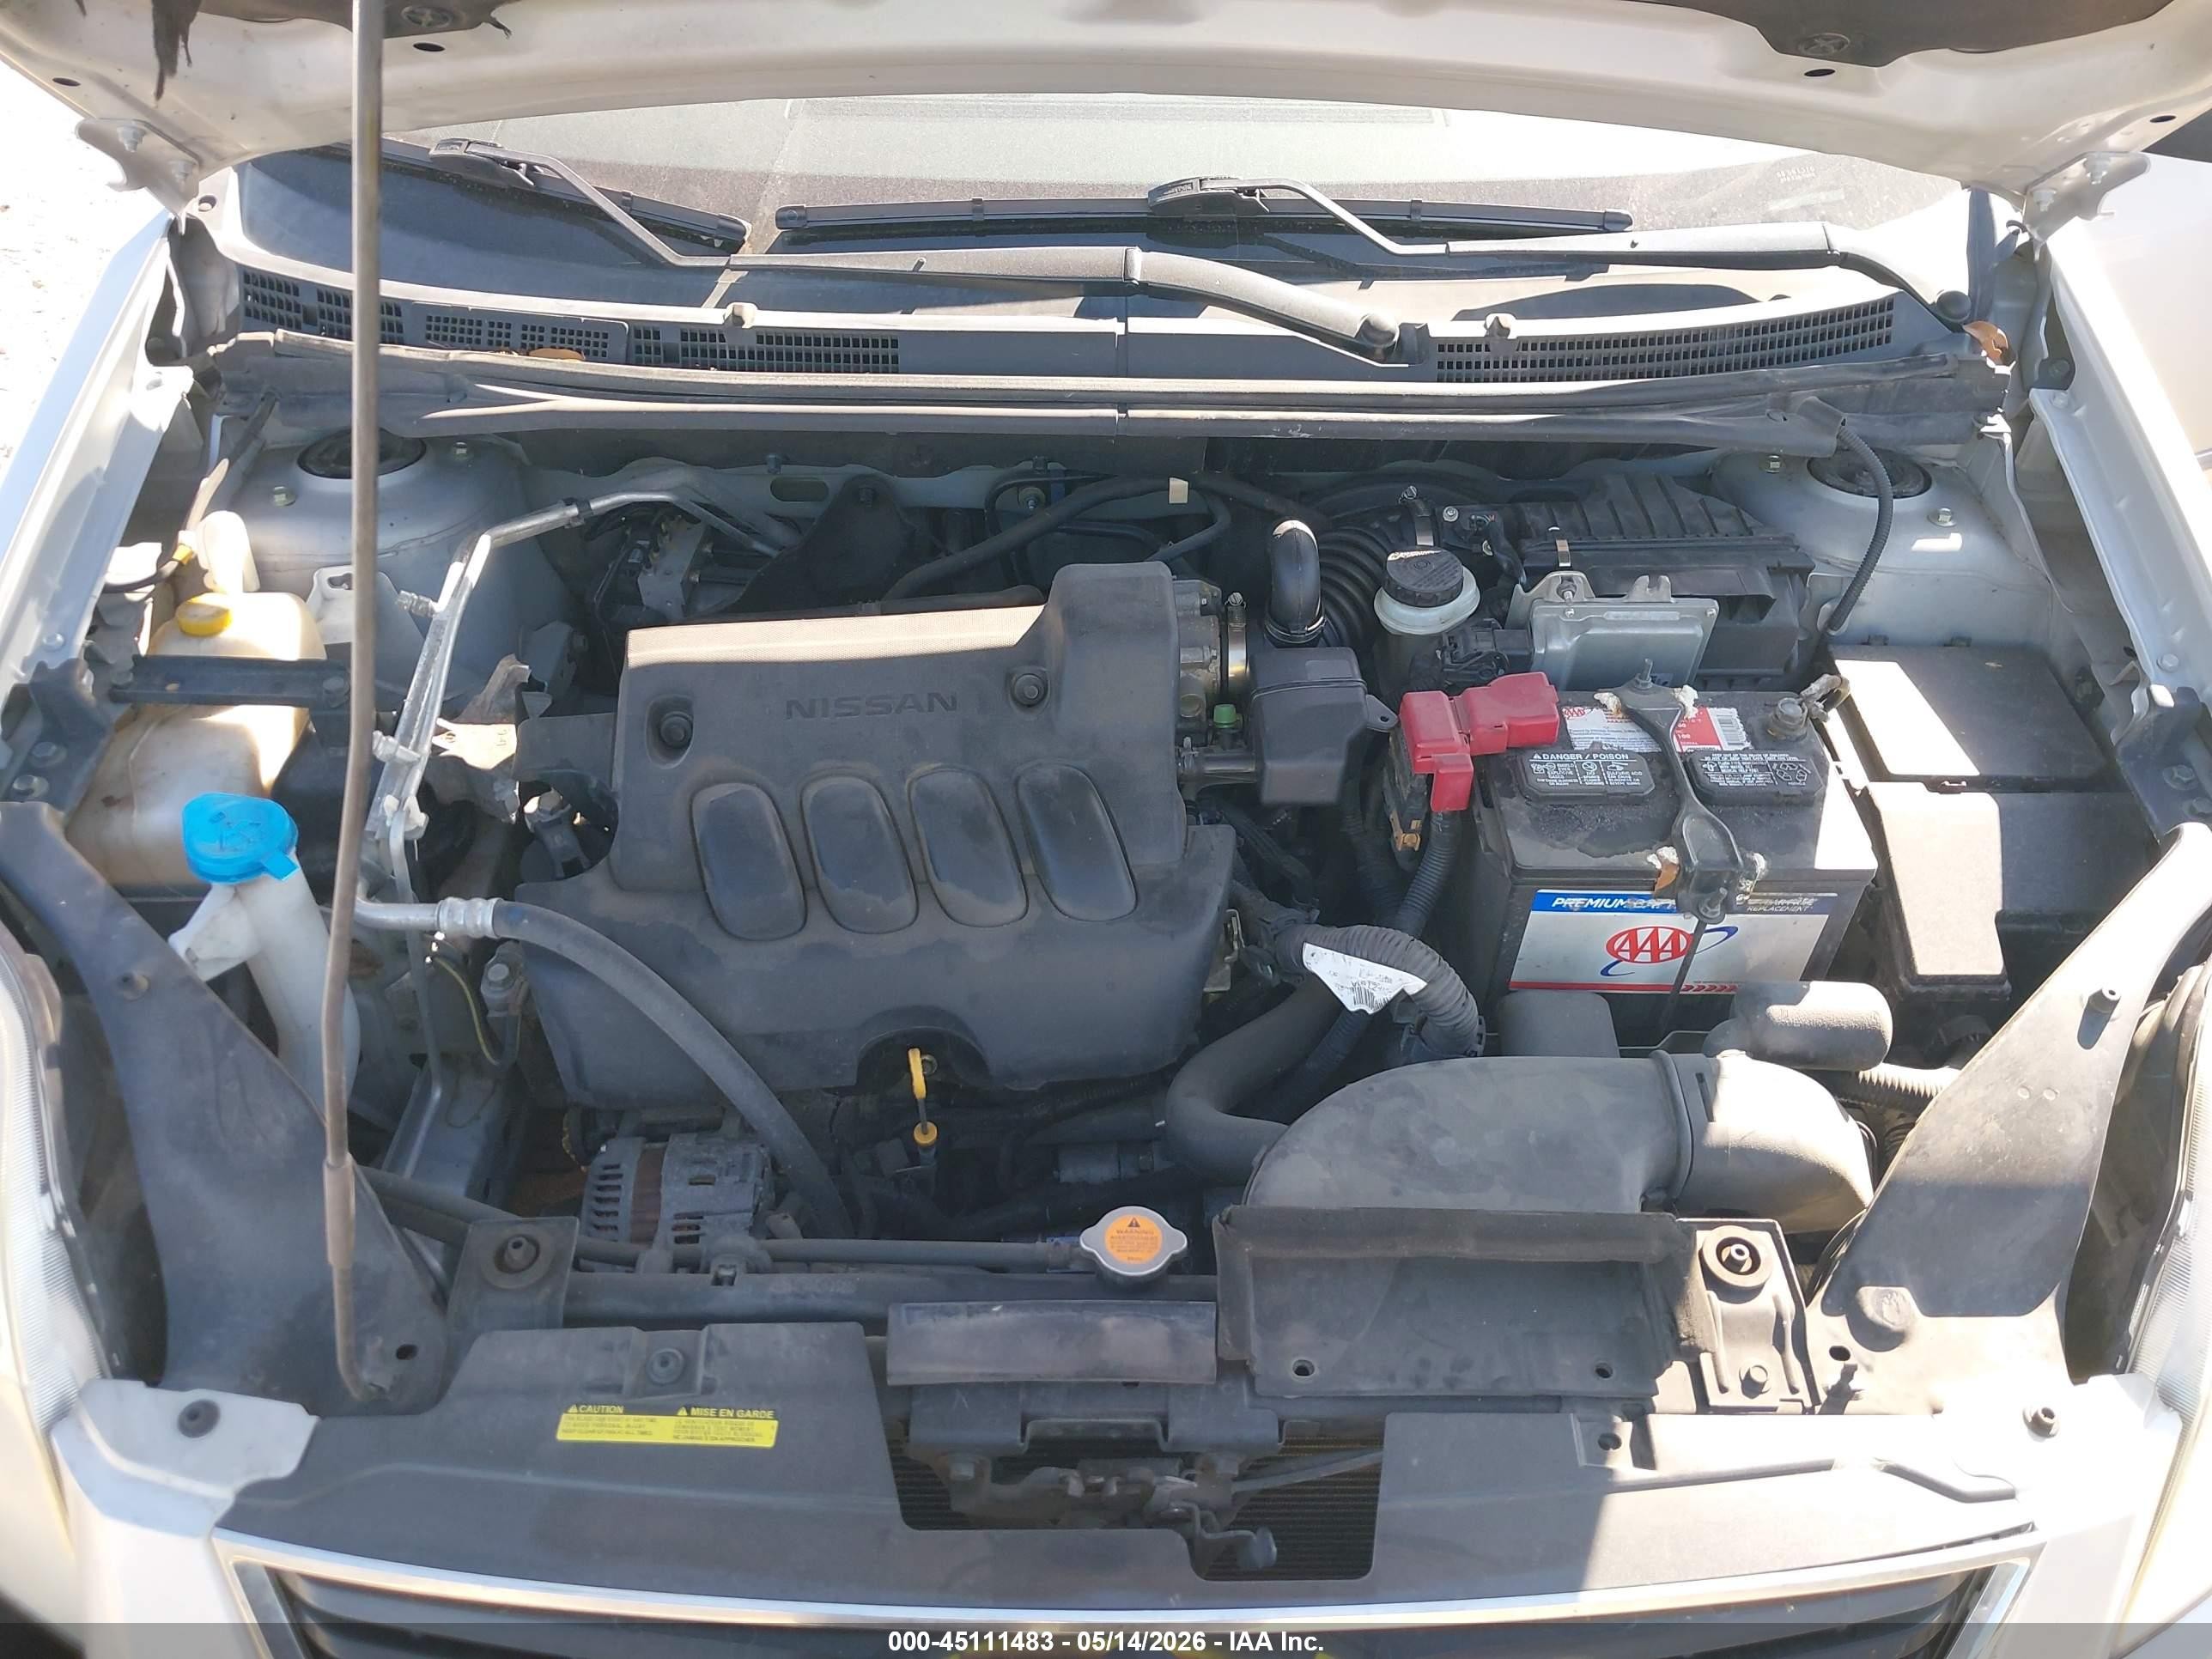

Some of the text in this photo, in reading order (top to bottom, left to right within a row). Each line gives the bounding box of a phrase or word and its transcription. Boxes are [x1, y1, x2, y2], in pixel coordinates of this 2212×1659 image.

[785, 692, 957, 720] NISSAN
[1552, 897, 1627, 908] PREMIUM
[1608, 927, 1689, 963] AAA
[579, 1404, 624, 1413] CAUTION
[690, 1407, 775, 1419] MISE EN GARDE
